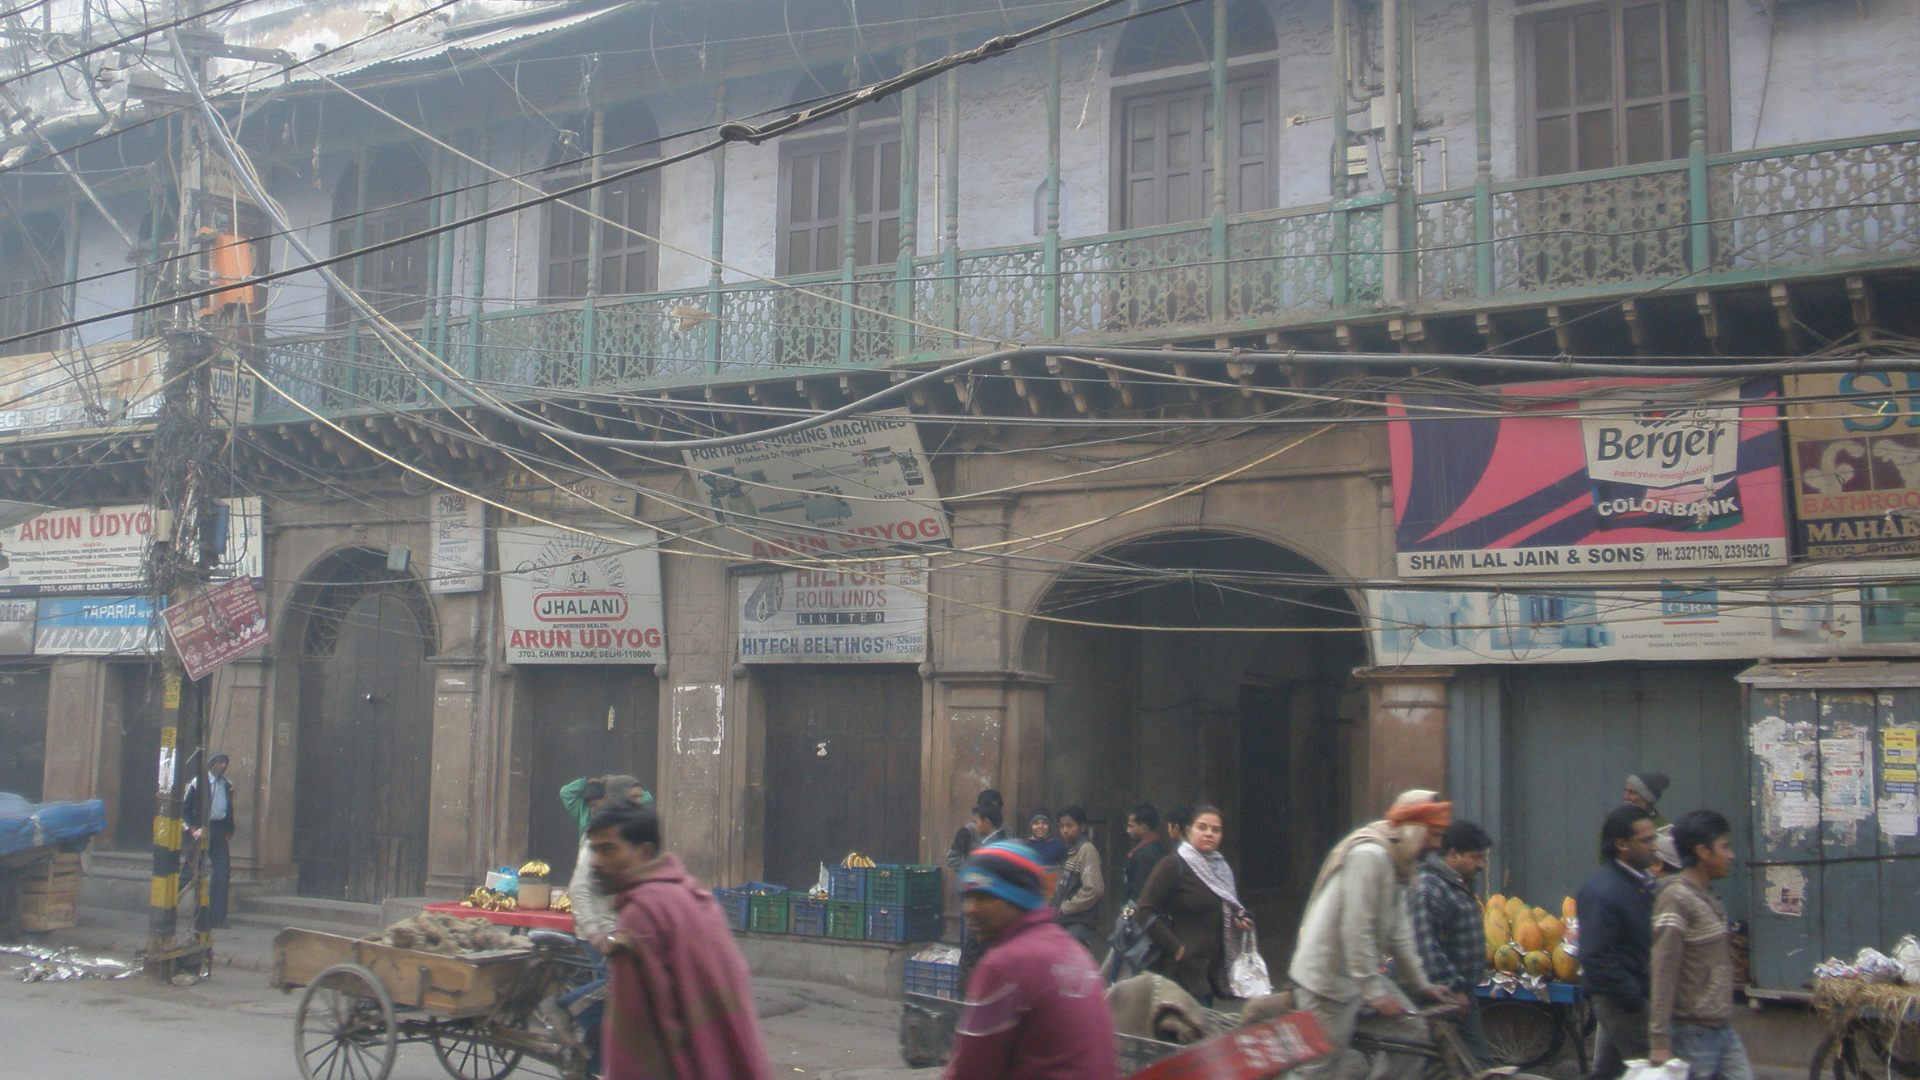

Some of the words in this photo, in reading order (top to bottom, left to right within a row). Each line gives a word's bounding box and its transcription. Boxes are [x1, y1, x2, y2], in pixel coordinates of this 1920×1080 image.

[690, 439, 759, 461] PORTABLE
[764, 427, 827, 449] FOGGING
[830, 418, 906, 439] MACHINES
[1597, 427, 1726, 469] Berger
[734, 451, 770, 466] (Products
[832, 441, 846, 450] Pvt.
[847, 437, 867, 447] Ltd.)
[1613, 470, 1637, 478] Paint
[1638, 471, 1658, 479] your
[1659, 465, 1711, 480] imaginatio
[1598, 497, 1738, 517] COLORBANK
[19, 516, 81, 541] ARUN
[89, 511, 151, 537] UDYO
[752, 534, 829, 558] ARUN
[838, 517, 940, 548] UDYOG
[1410, 553, 1465, 571] SHAM
[1471, 551, 1508, 569] LAL
[1513, 549, 1560, 567] JAIN
[1566, 548, 1581, 565] &
[1588, 546, 1646, 564] SONS
[1656, 547, 1673, 562] PH:
[1674, 546, 1722, 563] 23271750,
[1725, 543, 1770, 559] 23319212
[1815, 545, 1856, 556] 3702
[796, 560, 886, 588] HILTON
[58, 583, 85, 592] CHAWRI
[541, 598, 620, 617] JHALANI
[797, 589, 888, 609] ROULUNDS
[1667, 601, 1713, 614] CERA
[82, 604, 136, 620] TAPARIA
[799, 612, 883, 624] LIMITED
[509, 628, 572, 651] ARUN
[579, 627, 662, 650] UDYOG
[742, 637, 800, 656] HITECH
[803, 636, 885, 655] BELTINGS
[1703, 640, 1738, 648] WHIRLPOOL
[518, 650, 538, 660] 3703,
[539, 650, 568, 660] CHAWRI
